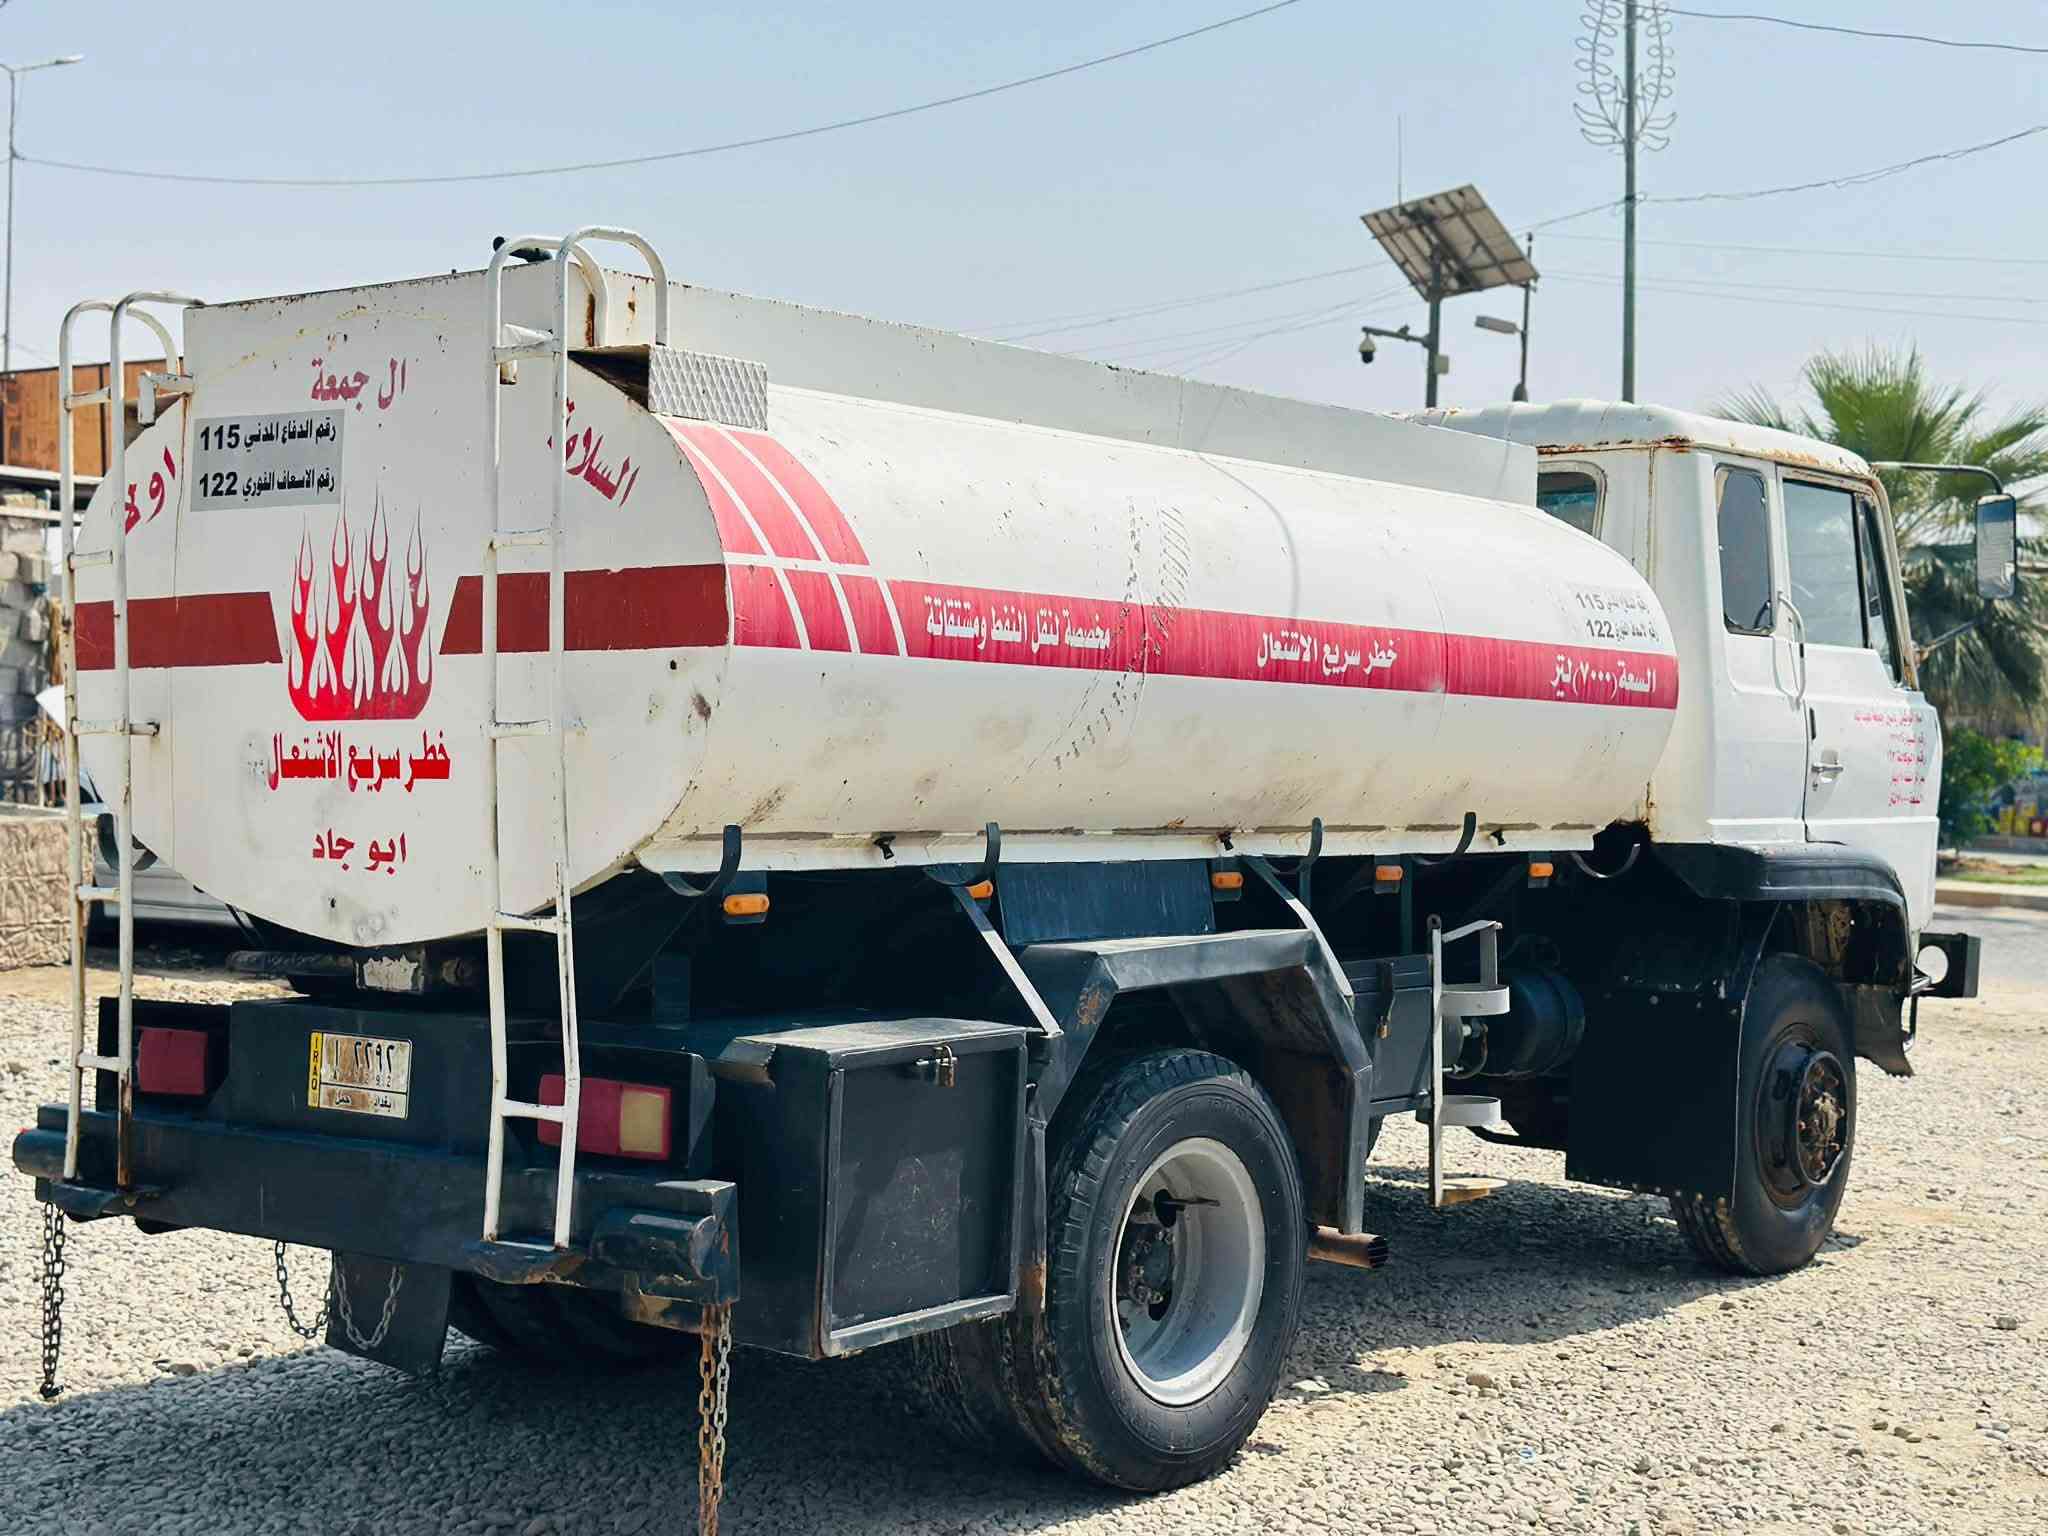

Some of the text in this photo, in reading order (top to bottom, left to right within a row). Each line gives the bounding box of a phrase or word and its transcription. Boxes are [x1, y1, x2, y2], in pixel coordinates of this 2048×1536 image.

[311, 356, 370, 412] جمعة
[200, 416, 336, 452] رقم الدفاع المدني 115
[199, 466, 335, 502] رقم الاسعاف الفوري 122
[1575, 591, 1605, 610] 115
[991, 603, 1028, 643] النفط
[1031, 607, 1060, 655] لنقل
[1586, 619, 1615, 639] 122
[1322, 641, 1361, 676] سريع
[1363, 637, 1398, 675] خطر
[1618, 660, 1656, 693] السعة
[266, 729, 451, 792] خطر سريع الاشتعال
[312, 828, 407, 875] ابو جاد
[310, 1036, 320, 1091] IRAQ
